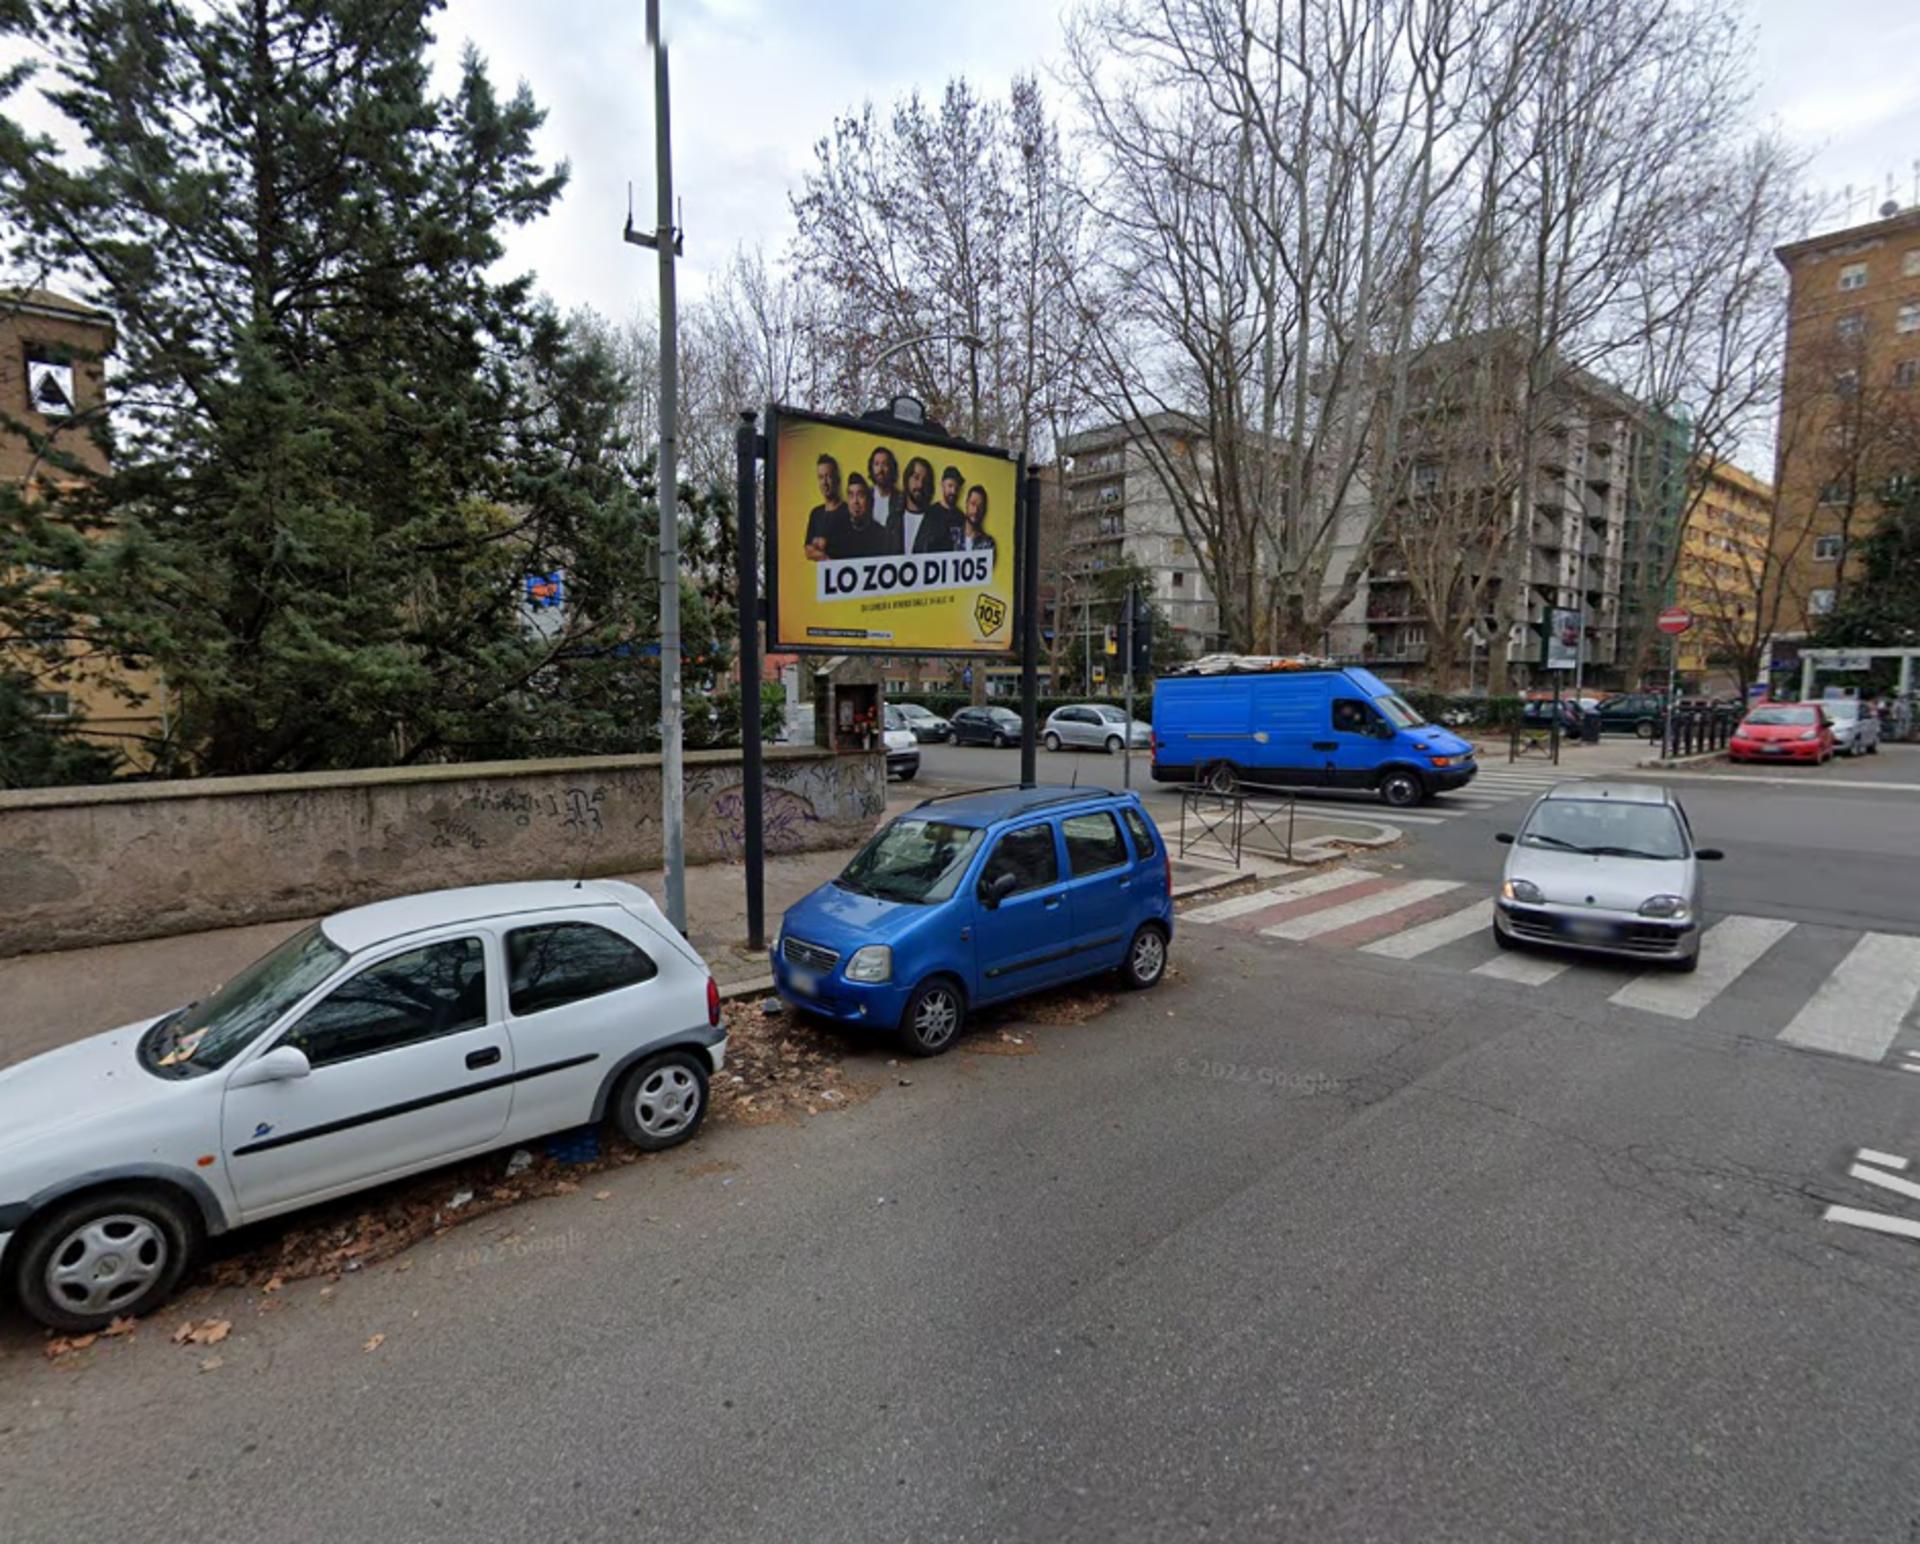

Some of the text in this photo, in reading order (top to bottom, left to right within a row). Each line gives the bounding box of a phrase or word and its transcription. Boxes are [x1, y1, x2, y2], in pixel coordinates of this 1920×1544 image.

[824, 557, 988, 595] LO ZOO DI 105
[978, 605, 1002, 627] 105
